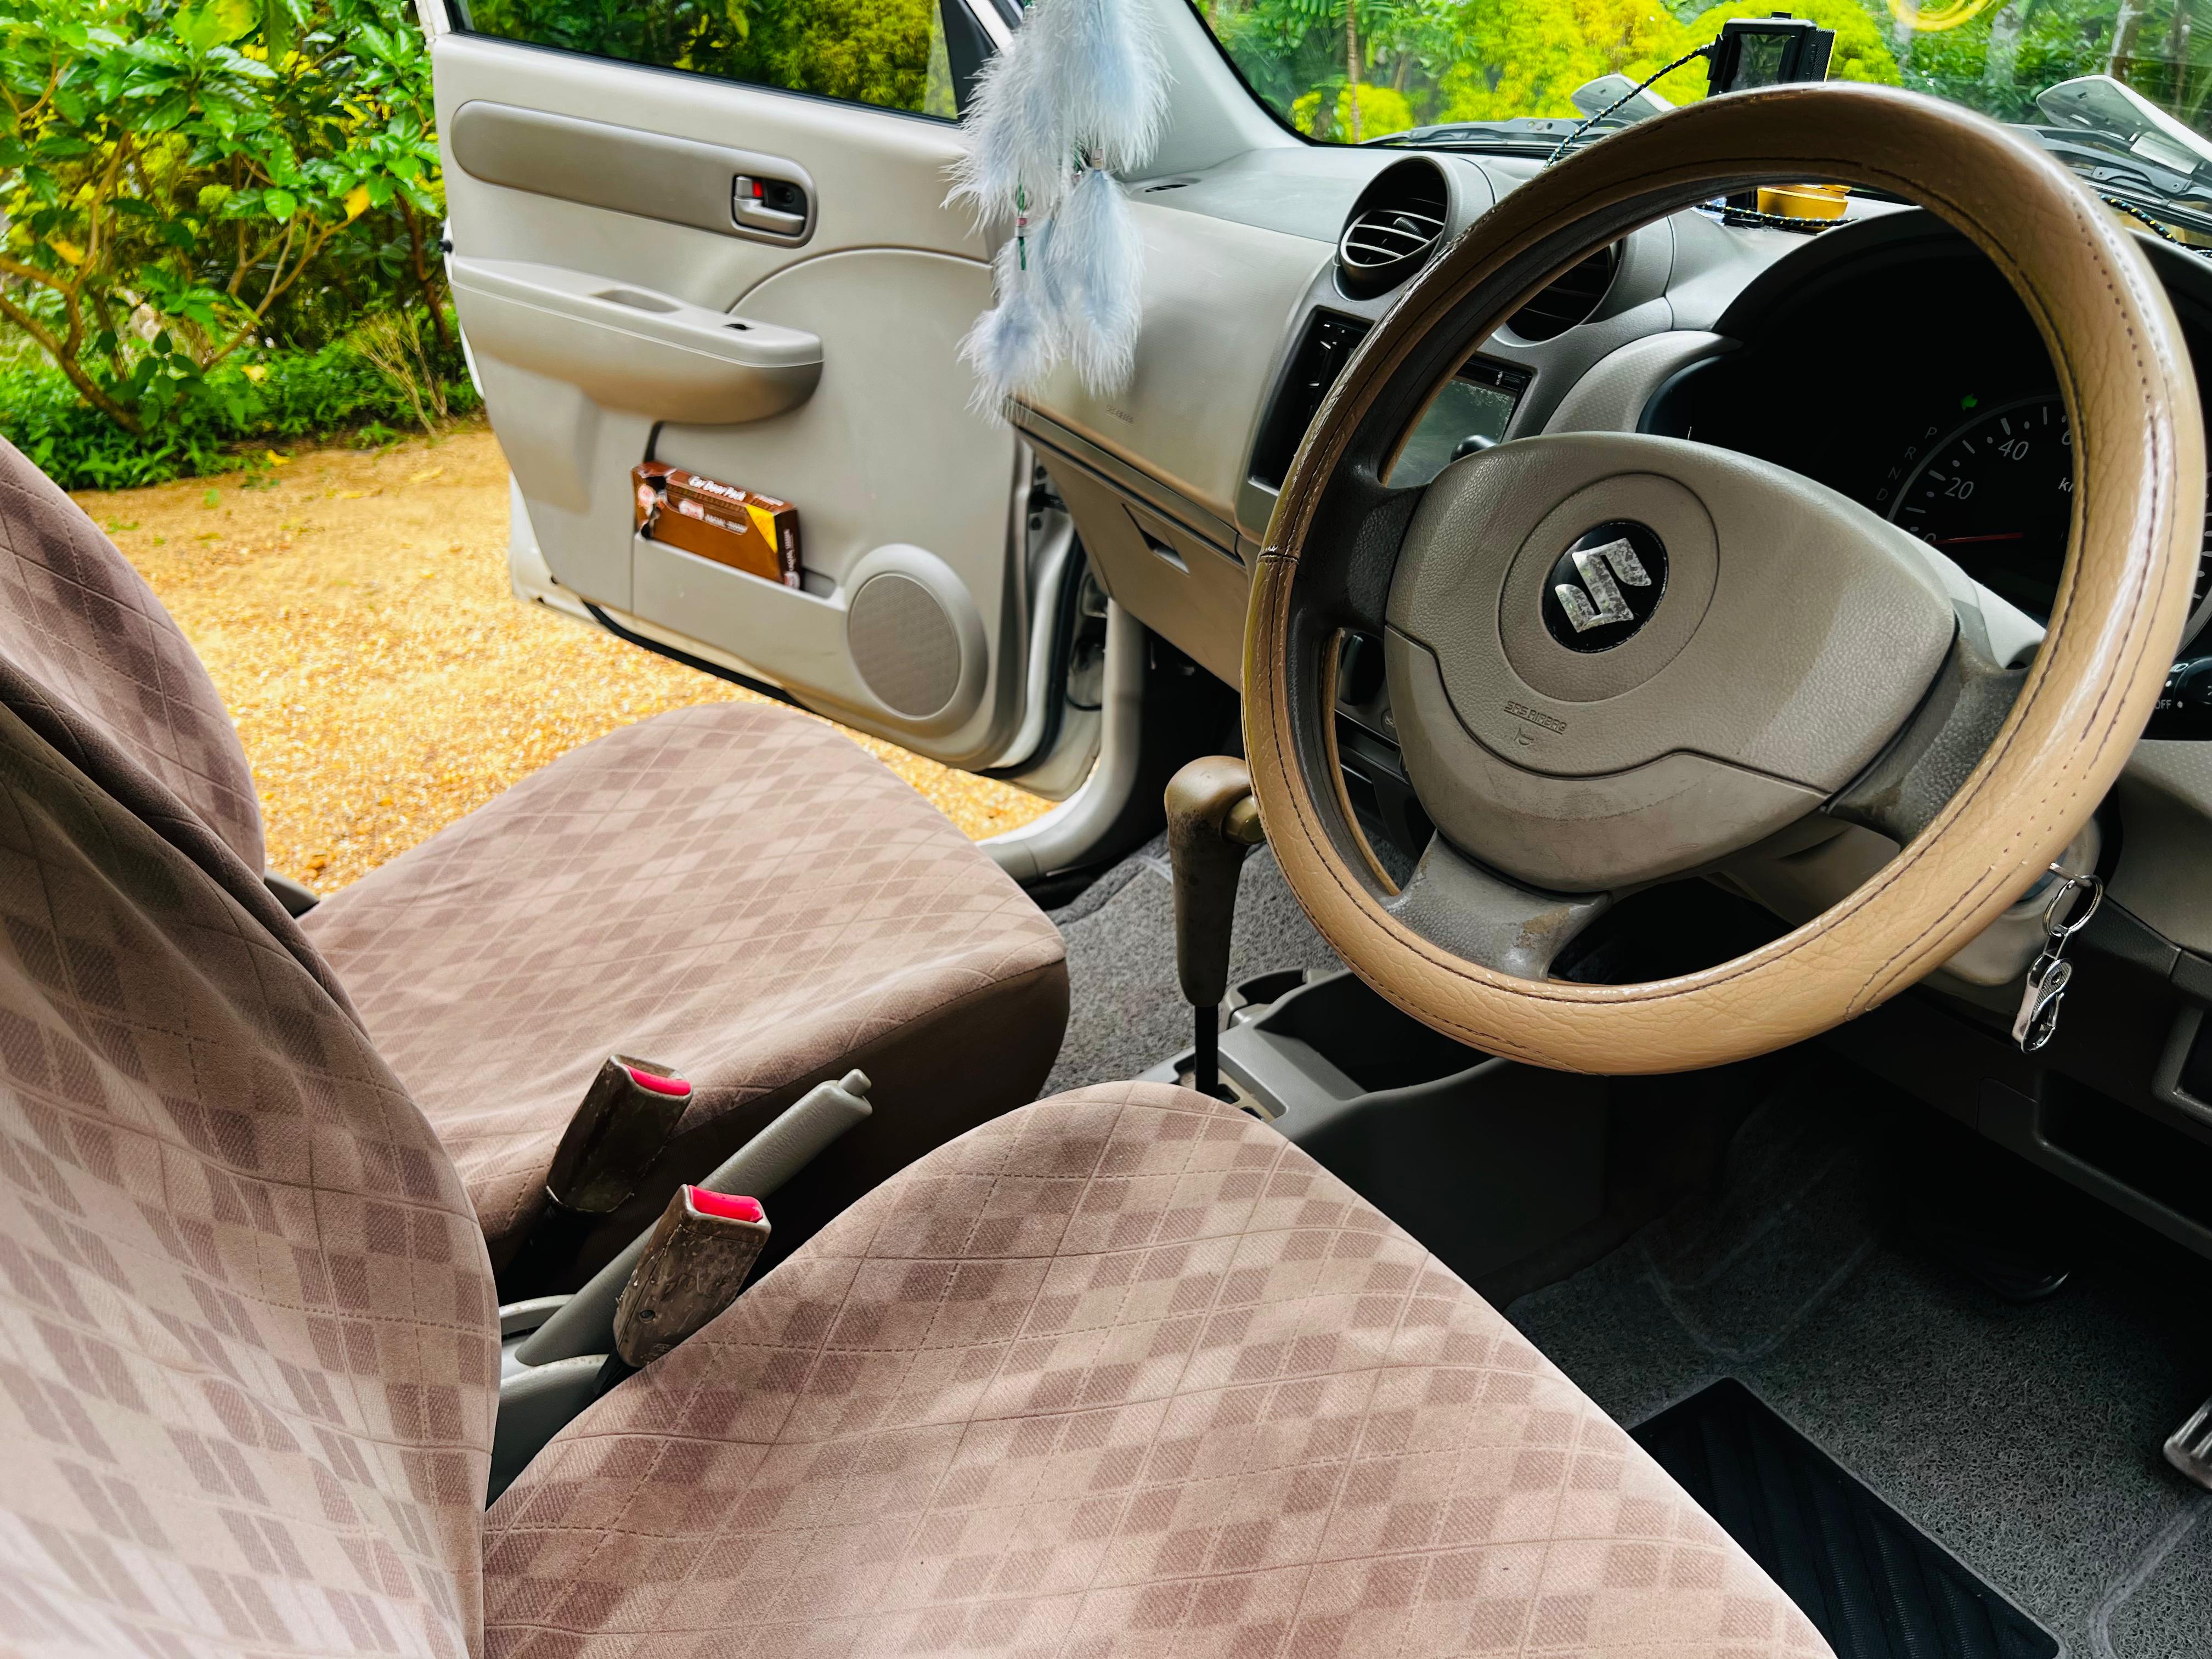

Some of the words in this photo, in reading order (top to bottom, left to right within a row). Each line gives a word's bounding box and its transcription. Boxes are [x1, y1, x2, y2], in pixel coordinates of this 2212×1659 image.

[1925, 426, 1938, 439] P
[1904, 446, 1916, 460] R
[1998, 438, 2029, 460] 40
[1888, 466, 1902, 480] N
[1876, 488, 1888, 501] D
[1944, 477, 1974, 500] 20
[1527, 709, 1567, 731] AIRBAG
